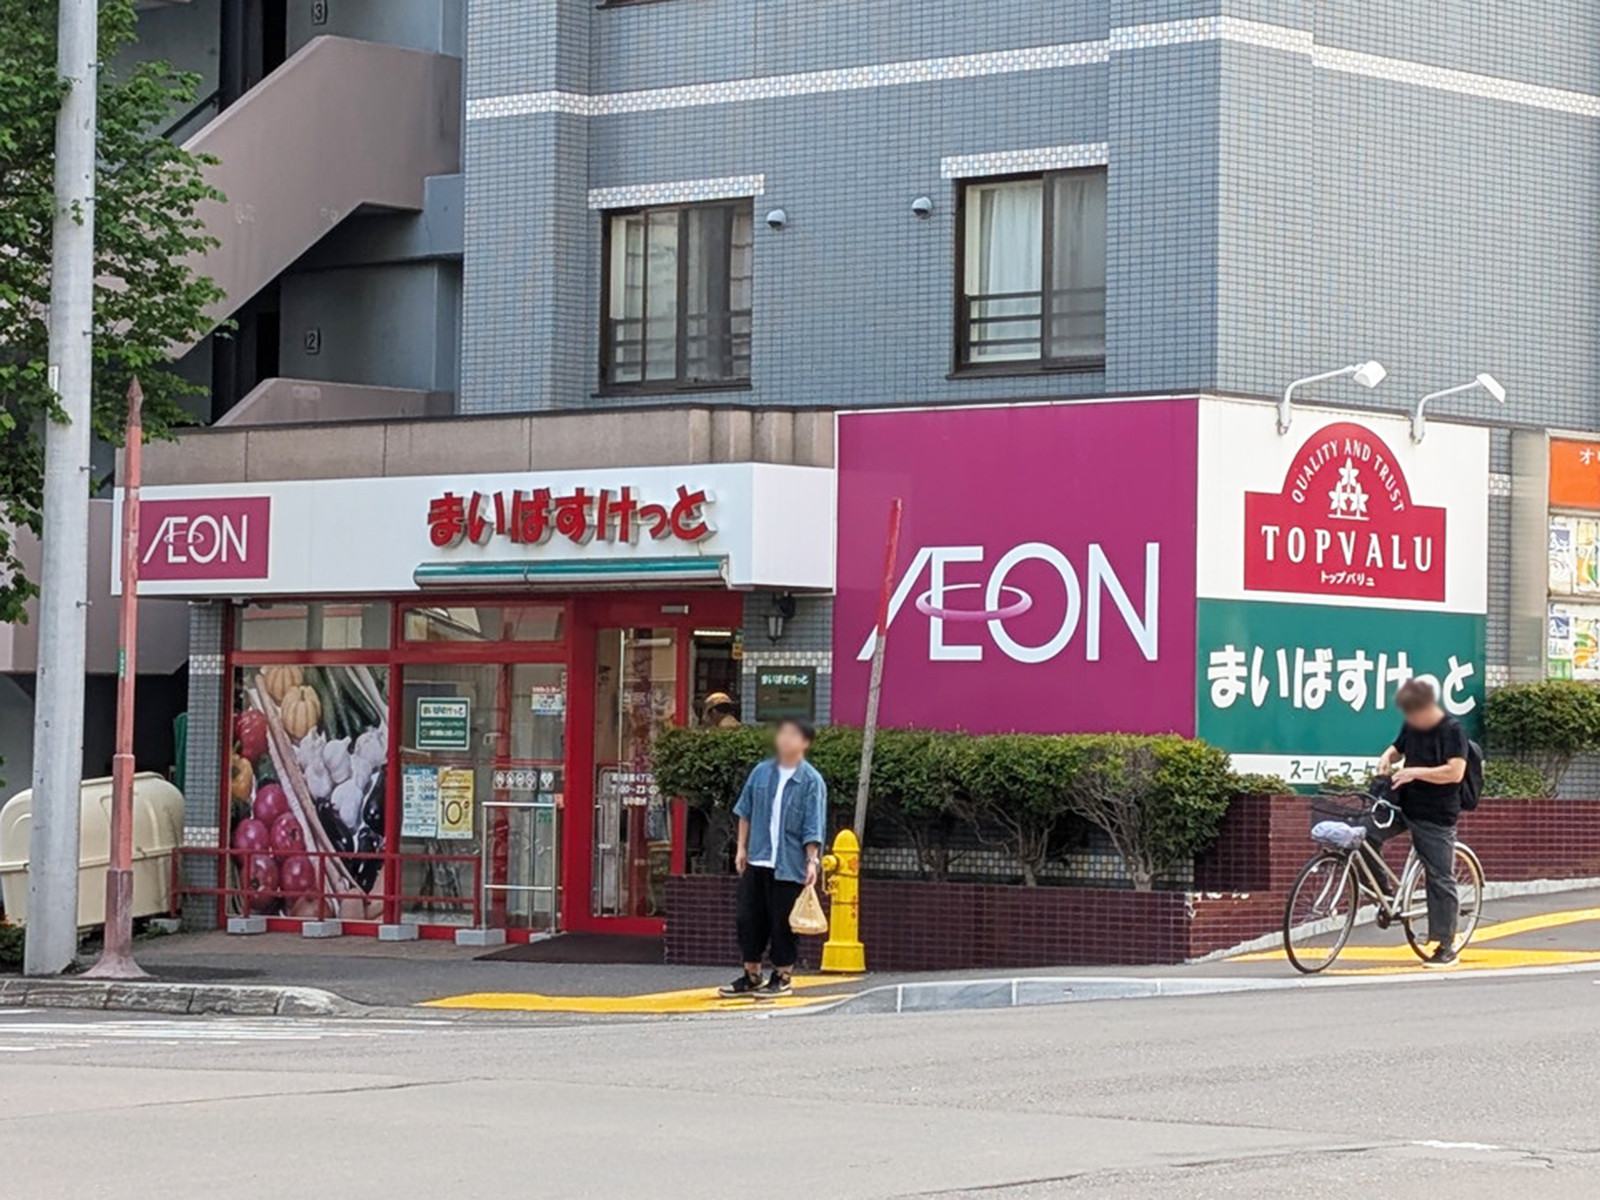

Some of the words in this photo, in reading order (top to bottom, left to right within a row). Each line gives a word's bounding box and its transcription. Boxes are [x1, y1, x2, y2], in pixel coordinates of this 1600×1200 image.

[1291, 440, 1339, 503] QUALITY
[1343, 438, 1371, 462] AND
[1373, 455, 1405, 512] TRUST
[1579, 448, 1600, 466] オ
[428, 484, 715, 547] まいばすけっと
[1261, 525, 1432, 572] TOPVALU
[1321, 570, 1376, 587] トップバリュ
